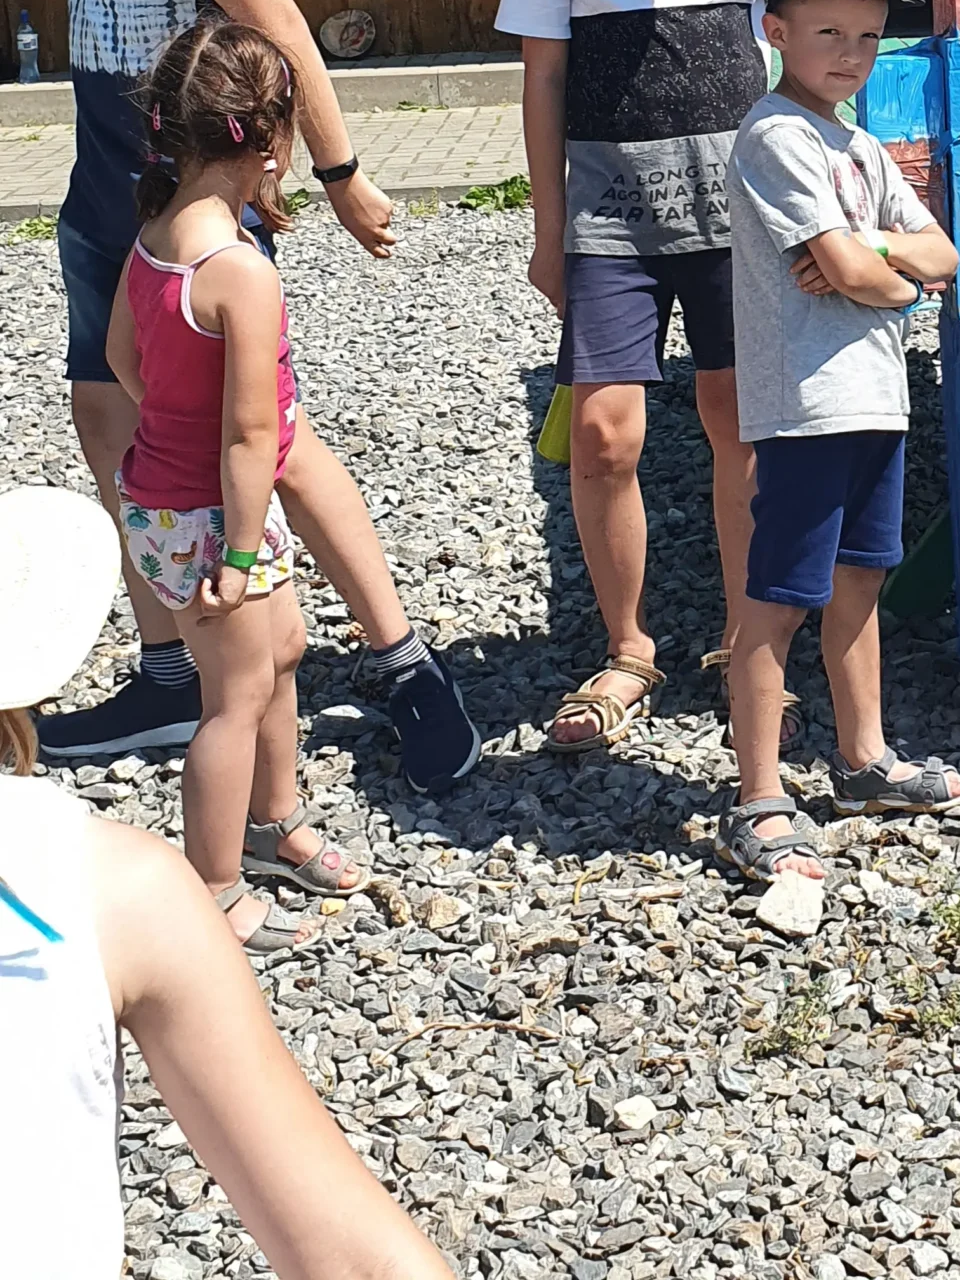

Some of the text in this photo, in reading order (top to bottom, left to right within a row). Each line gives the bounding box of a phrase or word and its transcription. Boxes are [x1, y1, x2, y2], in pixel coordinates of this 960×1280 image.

[612, 173, 625, 186] A
[636, 165, 700, 186] LONG
[600, 187, 642, 202] AGO
[649, 186, 668, 203] IN
[673, 184, 688, 199] A
[592, 205, 644, 222] FAR
[652, 203, 696, 223] FAR
